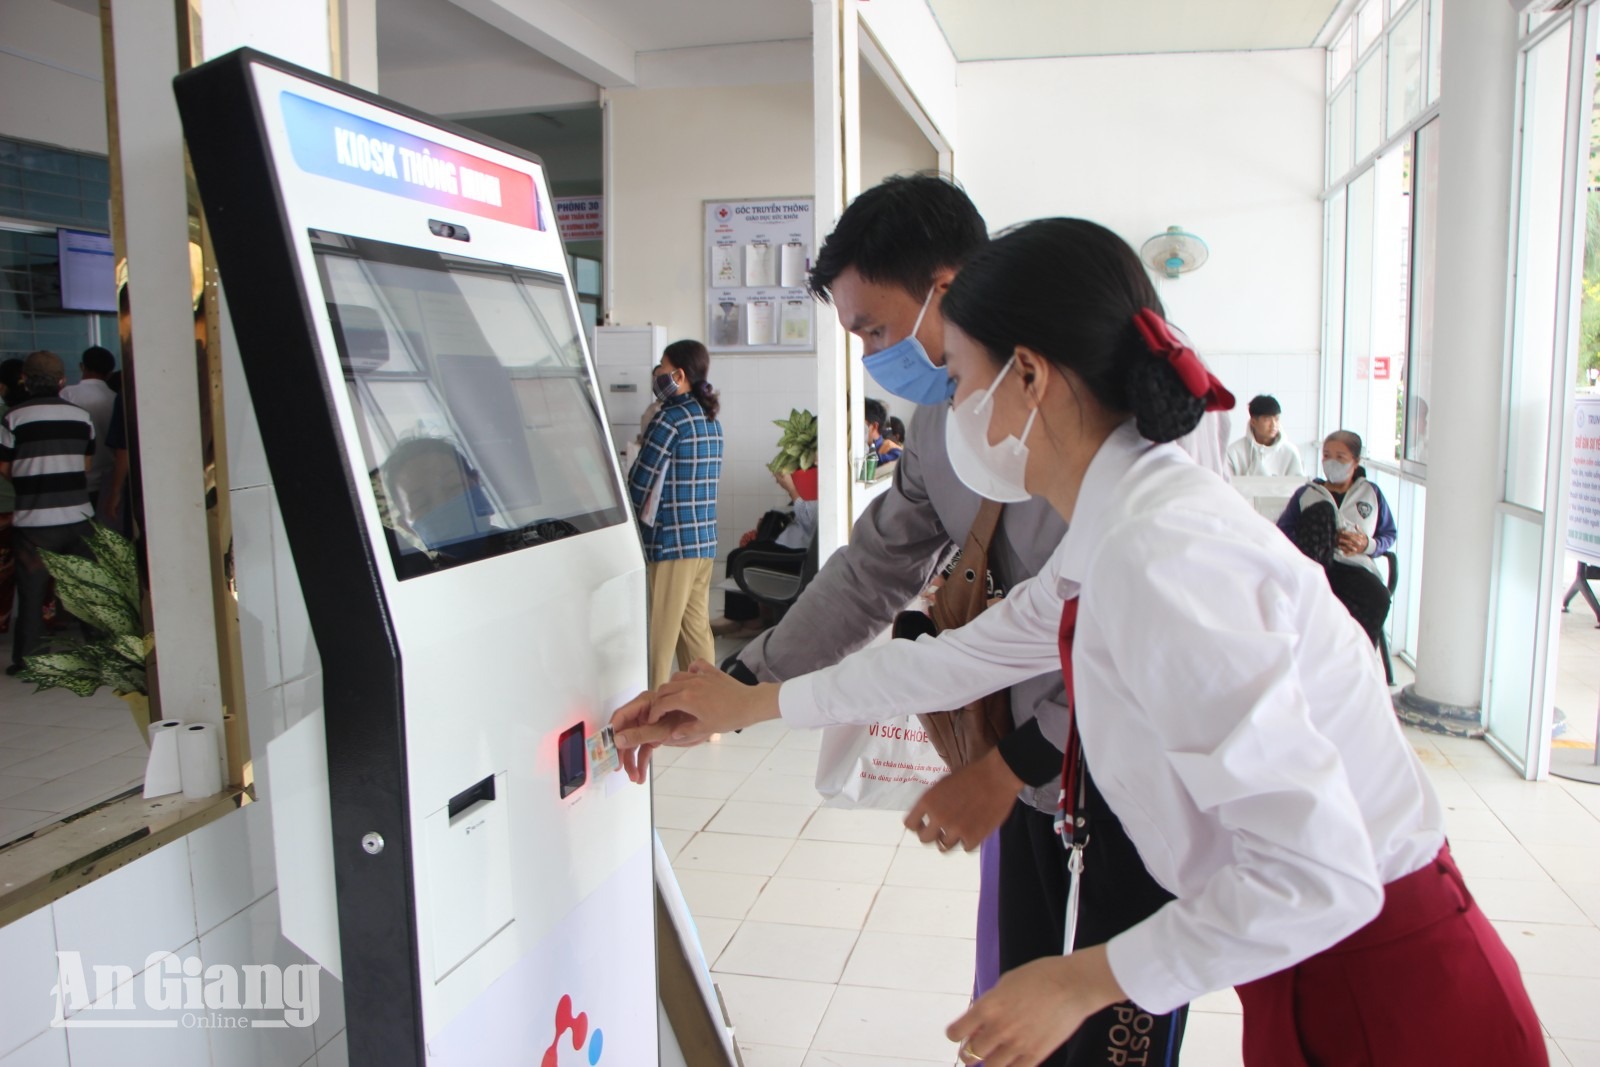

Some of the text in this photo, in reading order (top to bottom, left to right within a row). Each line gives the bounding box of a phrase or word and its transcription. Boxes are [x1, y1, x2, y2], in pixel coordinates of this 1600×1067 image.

[334, 126, 398, 179] KIOSK
[398, 148, 459, 195] THÔNG
[735, 203, 809, 215] GÓC TRUYỀN THÔNG
[869, 722, 879, 737] VÌ
[881, 724, 901, 740] SỨC
